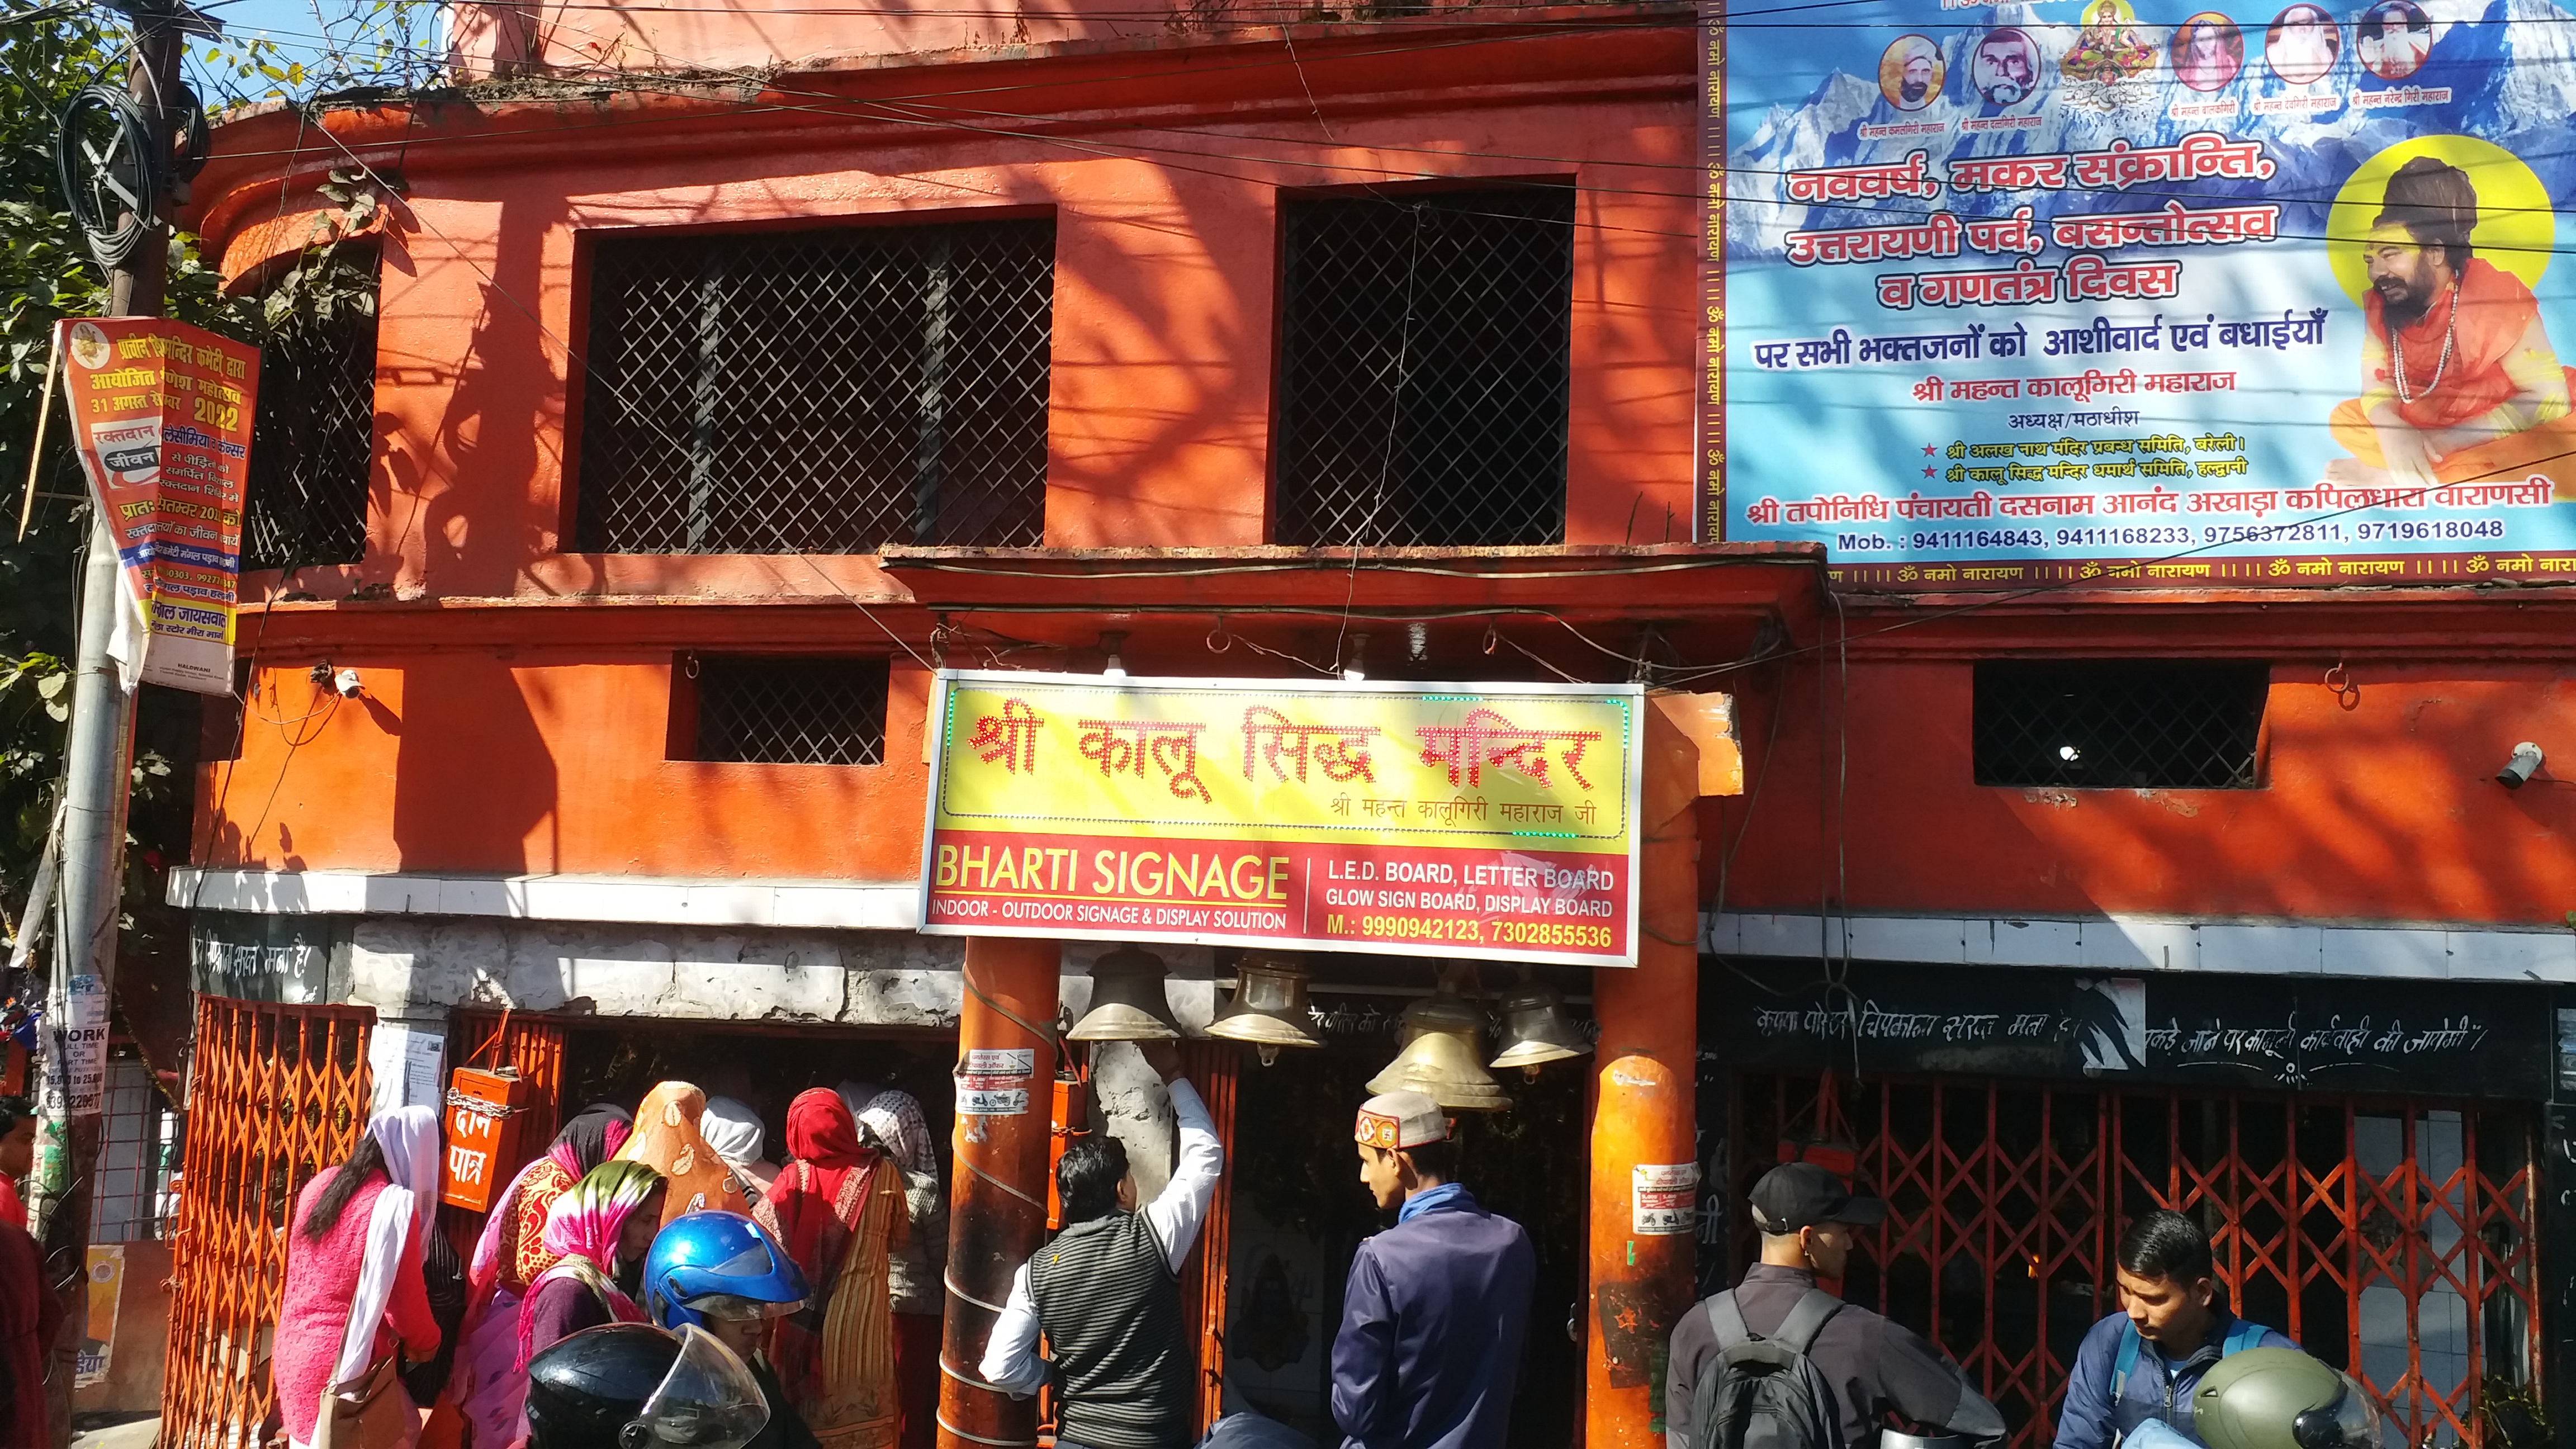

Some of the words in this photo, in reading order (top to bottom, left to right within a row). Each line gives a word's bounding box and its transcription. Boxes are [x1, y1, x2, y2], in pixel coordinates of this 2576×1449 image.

[2310, 97, 2336, 108] महाराज
[2422, 90, 2449, 101] महाराज
[1921, 123, 1945, 134] महाराज
[2018, 116, 2042, 127] महाराज
[1789, 151, 1939, 201] नववर्ष,
[1951, 155, 2070, 191] मकर
[2075, 135, 2275, 189] संक्रान्ति,
[1707, 214, 1720, 262] नारायण
[1788, 212, 1960, 263] उत्तरायणी
[1967, 206, 2044, 255] पर्व,
[2053, 200, 2279, 248] बसन्तोत्सव
[1879, 274, 1911, 308] व
[1920, 259, 2058, 305] गणतंत्र
[2066, 255, 2180, 299] दिवस
[1706, 326, 1725, 353] नमो
[1754, 342, 1790, 368] पर
[1795, 329, 1852, 367] सभी
[1858, 323, 1986, 363] भक्तजनों
[1988, 321, 2028, 357] को
[2169, 313, 2215, 352] एवं
[2218, 306, 2329, 351] बधाईयाँ
[90, 367, 156, 390] आयोजित
[1706, 357, 1720, 405] नारायण
[1912, 375, 1944, 402] श्री
[1950, 378, 2021, 401] महन्त
[2026, 368, 2137, 403] कालूगिरी
[2144, 372, 2237, 393] महाराज
[91, 398, 108, 413] 31
[193, 397, 239, 432] 2022
[93, 425, 155, 444] रक्तदान
[1946, 442, 1965, 458] श्री
[1969, 443, 2014, 458] अलख
[2018, 442, 2048, 456] नाथ
[2052, 438, 2088, 456] मंदिर
[2137, 435, 2191, 454] समिति,
[106, 452, 155, 468] जीवन
[1945, 463, 1965, 482] श्री
[1969, 466, 2008, 485] कालू
[2009, 463, 2043, 482] सिद्ध
[2048, 461, 2089, 479] मन्दिर
[2139, 457, 2194, 479] समिति,
[159, 479, 201, 494] रक्तदान
[1746, 496, 1779, 524] श्री
[1786, 496, 1890, 523] तपोनिधि
[1896, 491, 1993, 520] पंचायती
[2000, 494, 2096, 518] दसनाम
[2103, 486, 2179, 515] आनंद
[2186, 490, 2279, 518] अखाड़ा
[2285, 483, 2429, 511] कपिलधारा
[2434, 478, 2552, 506] वाराणसी
[189, 524, 218, 541] जीवन
[1913, 530, 2049, 550] 9411164843,
[2057, 526, 2196, 547] 9411168233,
[2204, 523, 2350, 545] 9756372811,
[2357, 520, 2504, 540] 9719618048
[1924, 564, 1957, 583] नमो
[1962, 566, 2024, 581] नारायण
[2147, 564, 2211, 579] नारायण
[2296, 557, 2333, 576] नमो
[2337, 561, 2405, 576] नारायण
[2496, 553, 2532, 572] नमो
[178, 663, 211, 673] HALDWANI
[967, 697, 1044, 776] श्री
[1077, 719, 1212, 804] कालू
[1240, 704, 1381, 784] सिद्ध
[1414, 707, 1602, 792] मन्दिर
[1330, 793, 1351, 817] श्री
[1362, 799, 1407, 818] महन्त
[1418, 795, 1489, 827] कालूगिरी
[1499, 802, 1564, 824] महाराज
[1575, 796, 1597, 826] जी
[935, 844, 1078, 893] BHARTI
[1092, 849, 1289, 901] SIGNAGE
[1327, 859, 1379, 882] L.E.D.
[1385, 861, 1457, 888] BOARD,
[1464, 864, 1537, 889] LETTER
[1543, 868, 1614, 892] BOARD
[932, 899, 989, 918] INDOOR
[1002, 902, 1073, 922] OUTDOOR
[1077, 906, 1139, 925] SIGNAGE
[1142, 908, 1153, 925] &
[1156, 909, 1211, 928] DISPLAY
[1213, 911, 1286, 931] SOLUTION
[1326, 888, 1374, 908] GLOW
[1377, 891, 1416, 910] SIGN
[1420, 892, 1480, 915] BOARD,
[1485, 895, 1552, 917] DISPLAY
[1555, 898, 1613, 918] BOARD
[1362, 916, 1485, 945] 9990942123,
[1491, 920, 1612, 949] 7302855536
[264, 945, 293, 975] मना
[54, 1027, 106, 1042] WORK
[2223, 1028, 2249, 1055] पर
[73, 1075, 81, 1085] to
[449, 1145, 487, 1186] पात्र
